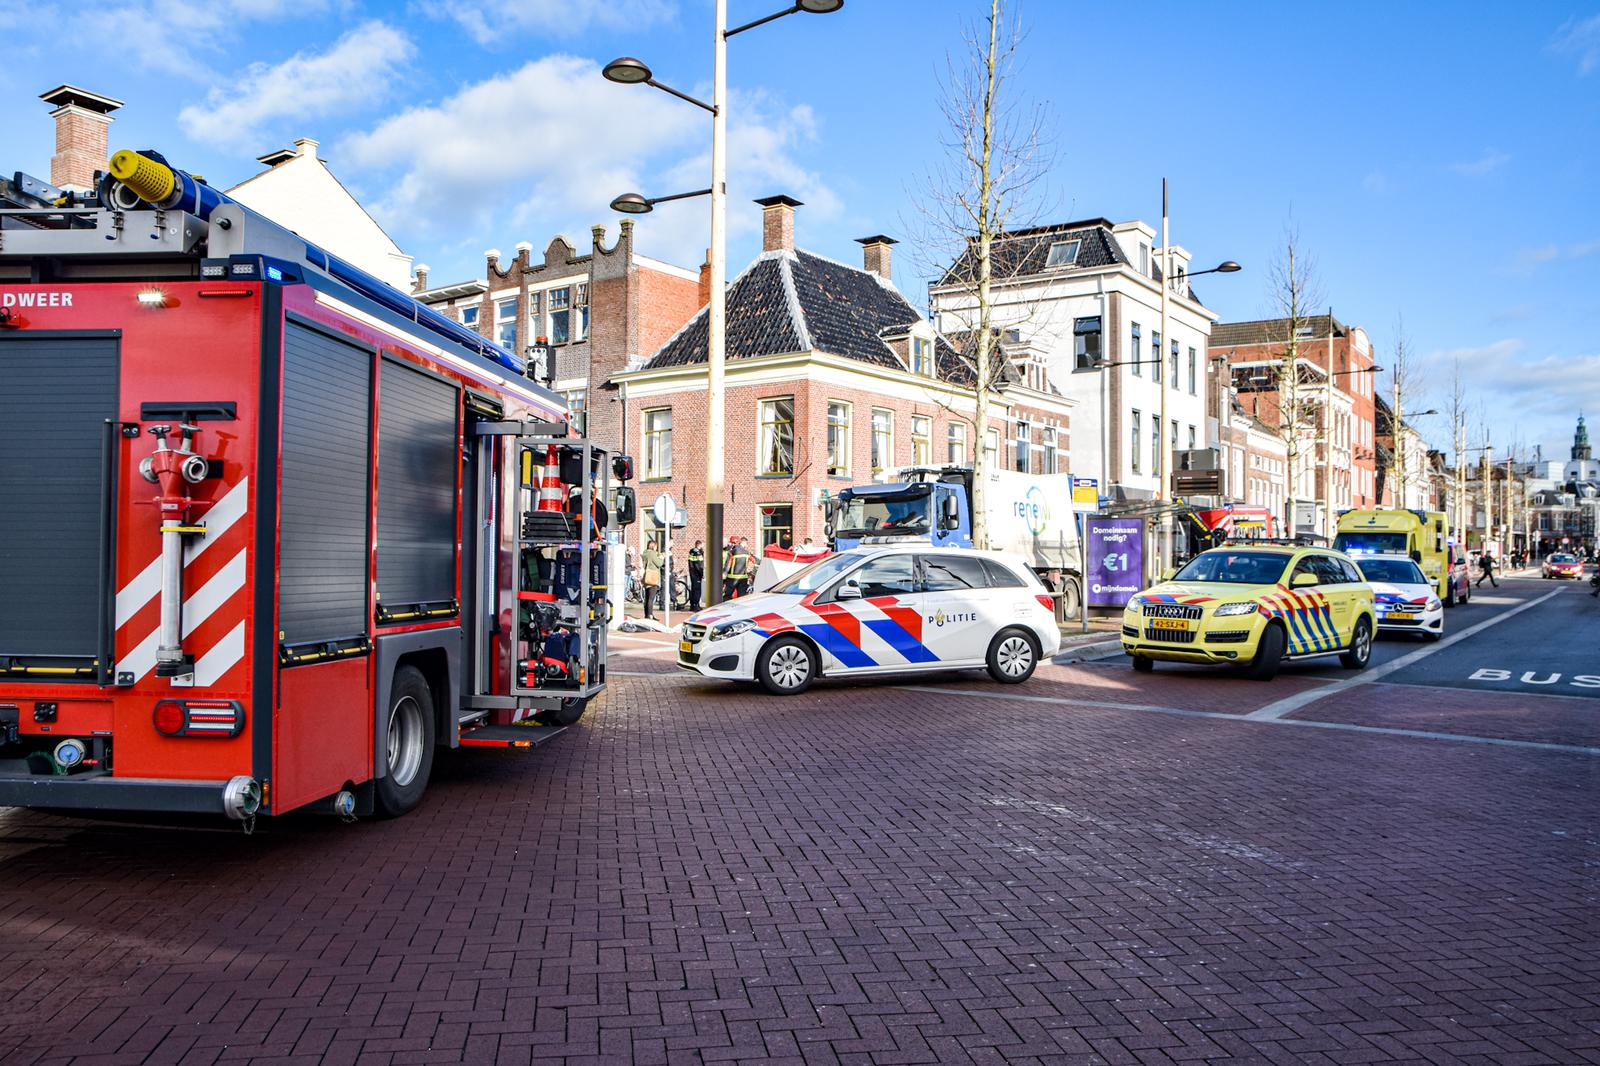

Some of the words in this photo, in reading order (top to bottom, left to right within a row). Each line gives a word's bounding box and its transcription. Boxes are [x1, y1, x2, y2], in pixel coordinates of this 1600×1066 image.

[3, 292, 73, 307] DWEER
[1103, 535, 1127, 543] nodig?
[1103, 553, 1128, 571] €1
[1101, 585, 1139, 593] mijndomein
[928, 611, 977, 627] POLITIE
[1468, 668, 1600, 688] BUS
